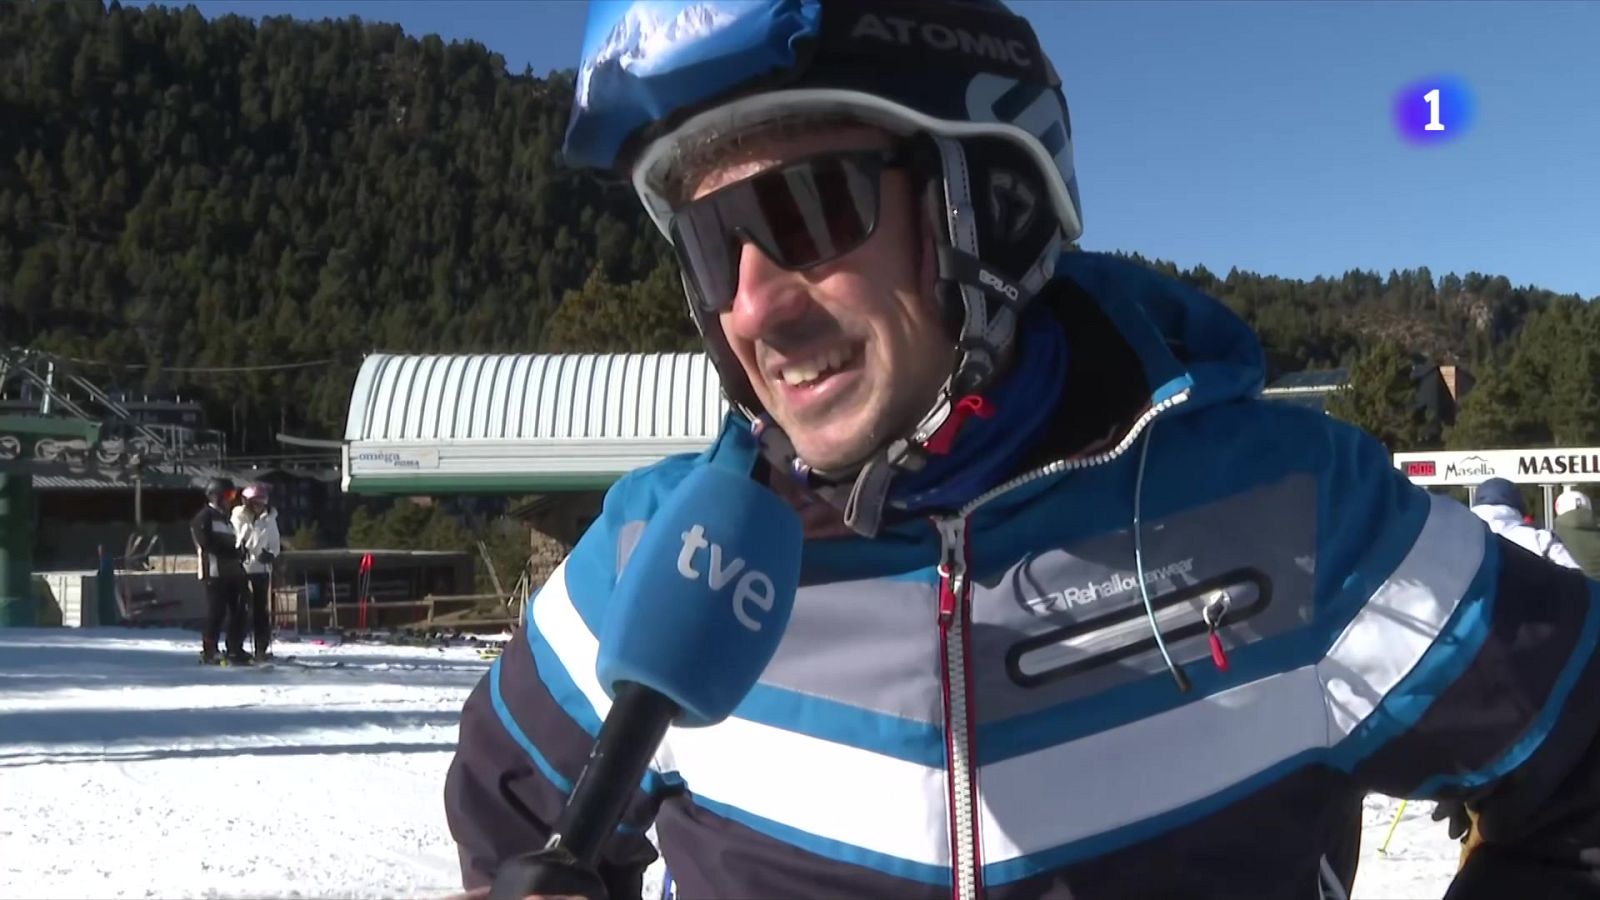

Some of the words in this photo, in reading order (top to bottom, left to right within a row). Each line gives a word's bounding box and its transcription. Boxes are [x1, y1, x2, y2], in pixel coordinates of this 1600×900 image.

[852, 13, 1031, 67] ATOMIC
[1445, 462, 1496, 480] Masella
[677, 524, 775, 632] tve
